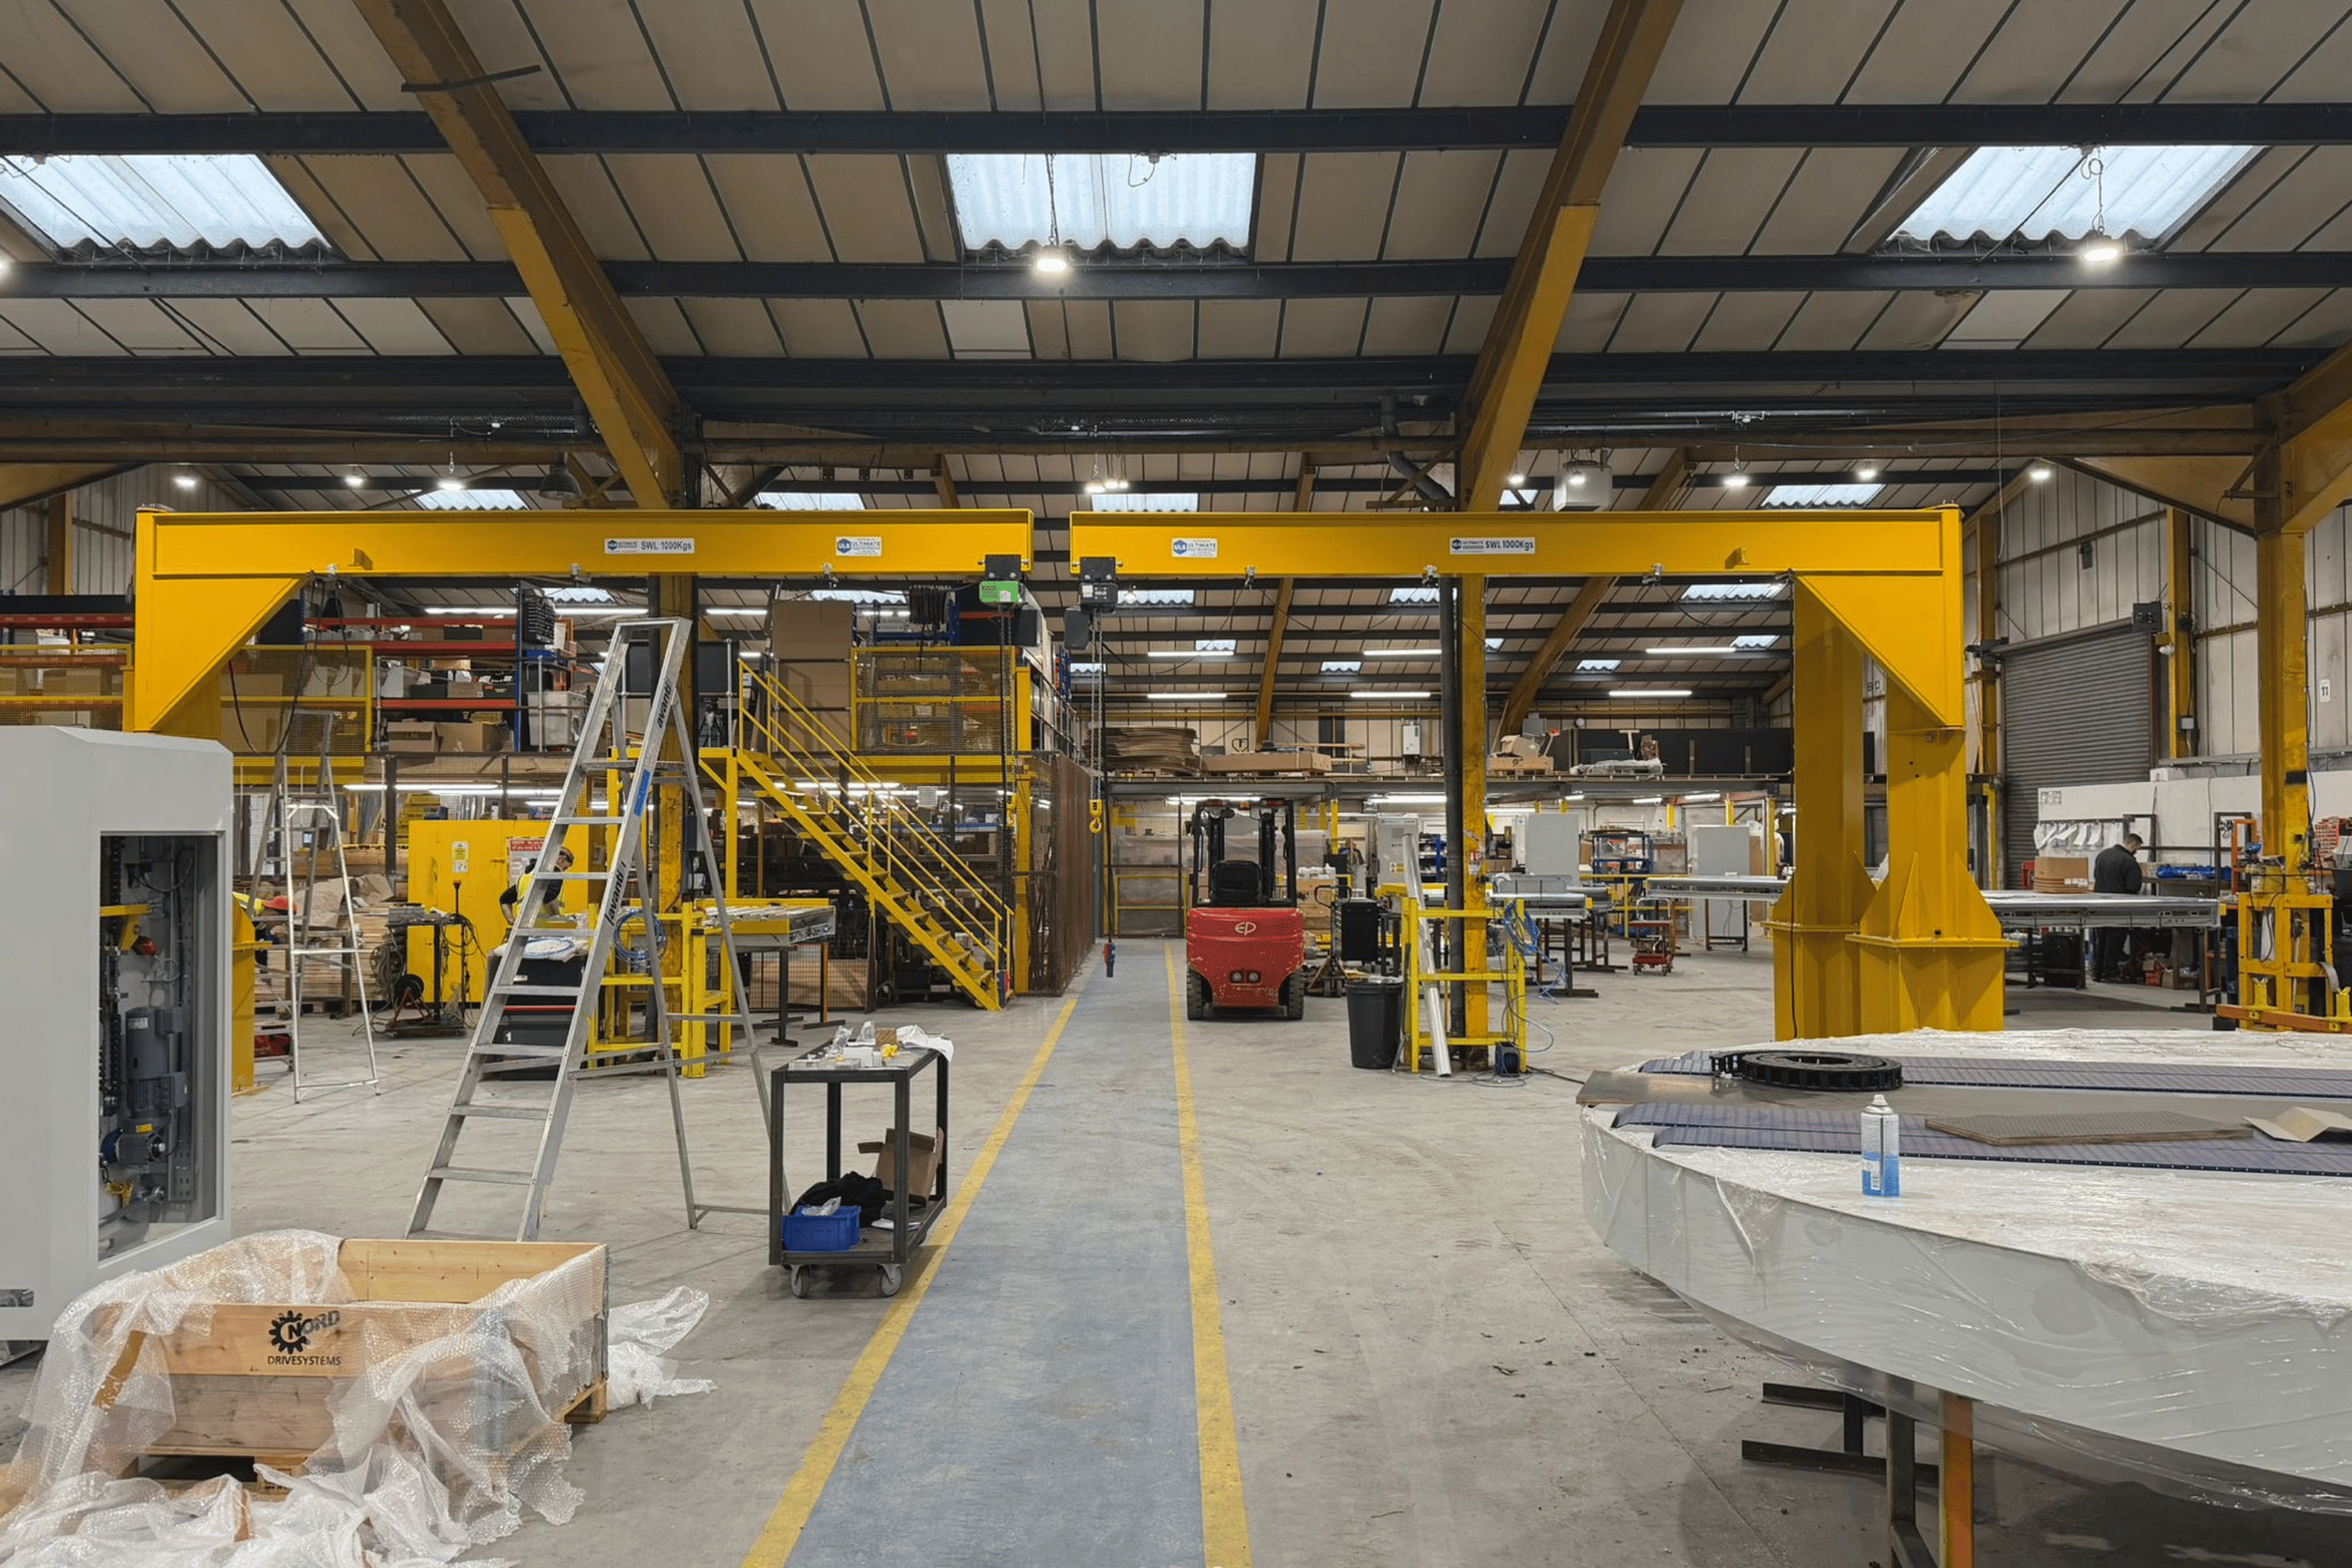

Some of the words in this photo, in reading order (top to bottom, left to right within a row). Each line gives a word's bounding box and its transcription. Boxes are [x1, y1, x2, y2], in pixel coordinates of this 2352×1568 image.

[641, 540, 659, 550] SWL
[661, 540, 692, 552] 1000Kgs
[1486, 540, 1502, 549] SWL
[1502, 540, 1534, 552] 1000Kgs
[2321, 686, 2328, 697] 11
[658, 682, 671, 728] avanti
[609, 869, 624, 920] avanti
[288, 1310, 341, 1340] NORD
[267, 1355, 342, 1366] DRIVESYSTEMS
